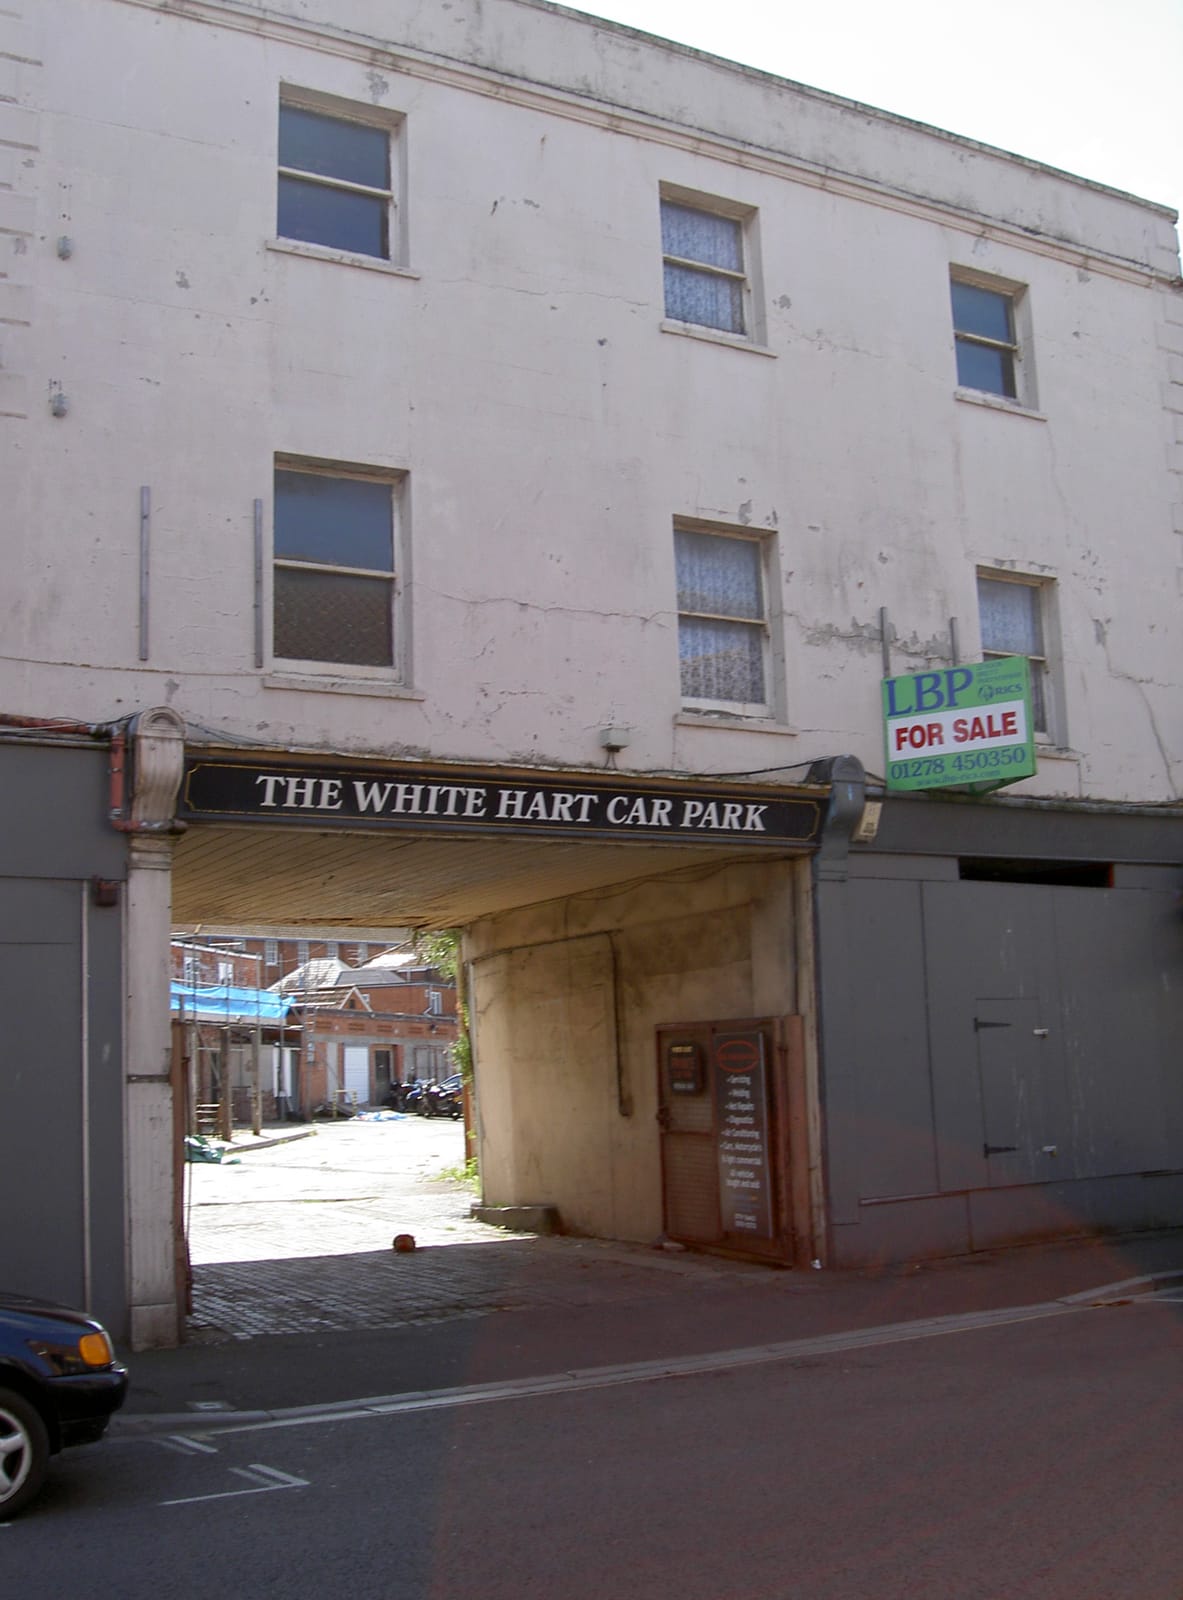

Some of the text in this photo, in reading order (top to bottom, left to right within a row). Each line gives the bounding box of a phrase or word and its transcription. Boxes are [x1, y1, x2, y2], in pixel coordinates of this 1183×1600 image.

[885, 668, 974, 717] LBP
[895, 711, 1018, 751] FOR SALE
[890, 747, 1026, 780] 01278 450350
[255, 775, 768, 832] THE WHITE HART CAR PARK
